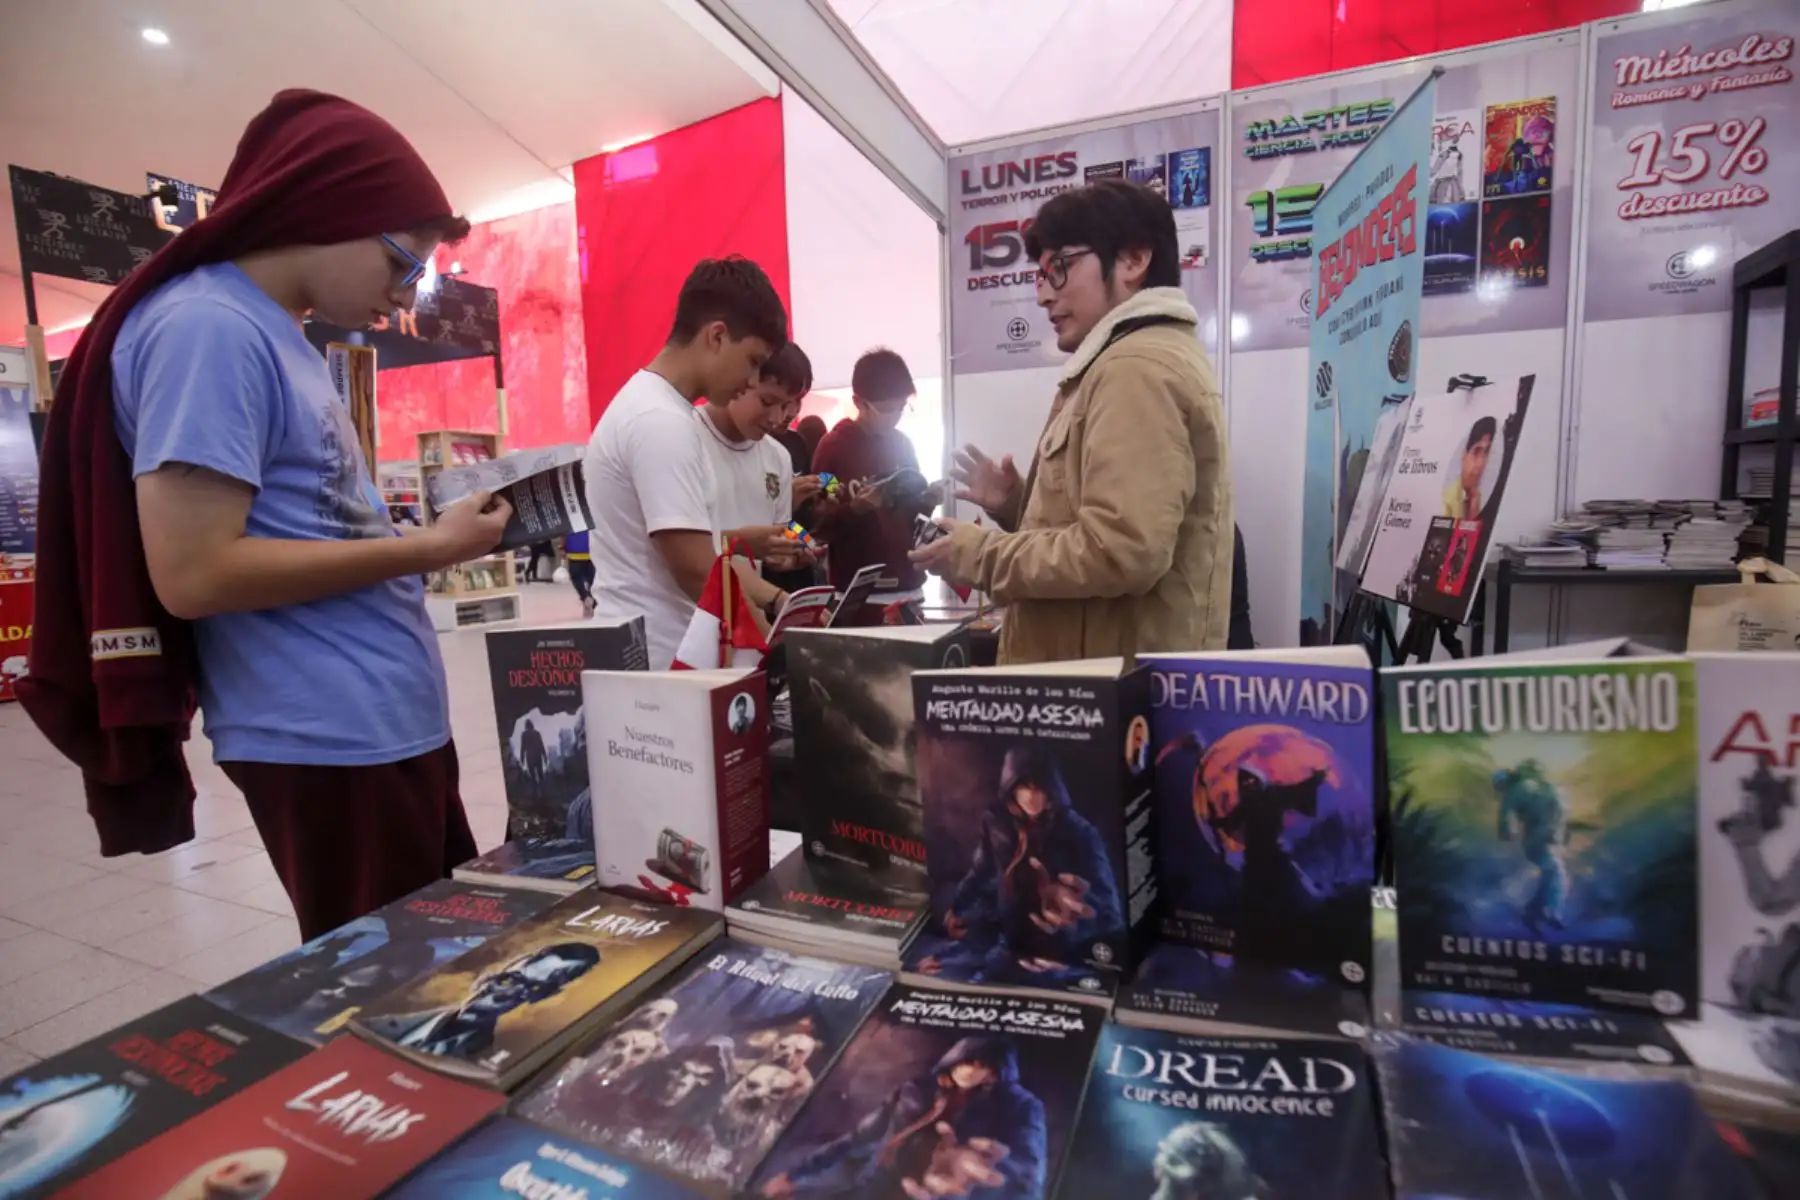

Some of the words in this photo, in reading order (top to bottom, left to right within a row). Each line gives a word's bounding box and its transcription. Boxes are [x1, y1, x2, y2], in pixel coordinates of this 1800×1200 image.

[1613, 32, 1794, 88] Miércoles
[1611, 86, 1686, 109] Romance
[1688, 81, 1706, 102] y
[1709, 65, 1793, 93] Fantasía
[1245, 98, 1395, 141] MARTES
[961, 151, 1078, 195] LUNES
[1616, 116, 1768, 191] 15%
[961, 194, 1008, 210] TERROR
[1009, 192, 1018, 203] Y
[1617, 184, 1769, 220] descuento
[964, 217, 1036, 272] 15
[967, 270, 1041, 291] DESCUE
[1387, 496, 1412, 513] Kevin
[530, 649, 585, 670] HECHOS
[1150, 672, 1369, 723] DEATHWARD
[1399, 672, 1678, 734] ECOFUTURISMO
[608, 739, 694, 774] Benefactores
[1442, 935, 1548, 961] CUENTOS
[1105, 1043, 1357, 1095] DREAD
[1122, 1083, 1199, 1110] cursed
[1206, 1094, 1335, 1118] innocence
